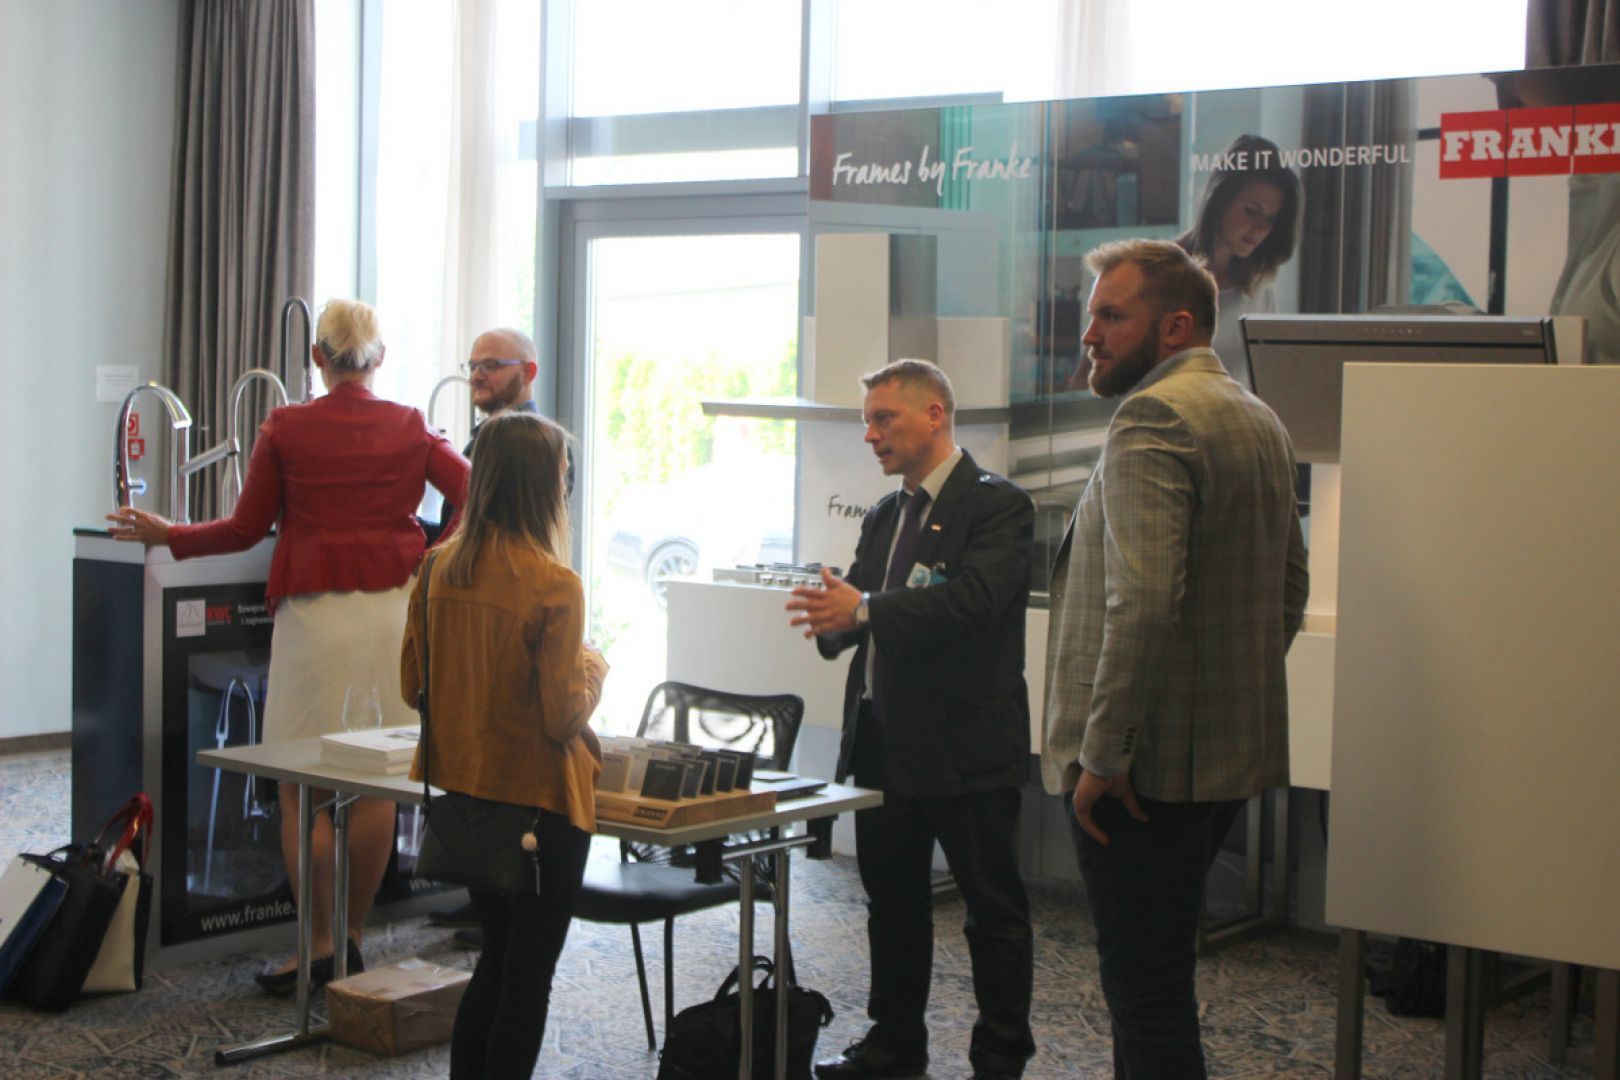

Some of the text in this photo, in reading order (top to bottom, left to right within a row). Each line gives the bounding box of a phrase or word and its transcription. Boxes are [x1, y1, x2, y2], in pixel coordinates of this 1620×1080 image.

[832, 141, 1032, 197] Frames by Franke
[1192, 144, 1411, 171] MAKE IT WONDERFUL
[828, 494, 873, 518] Fram
